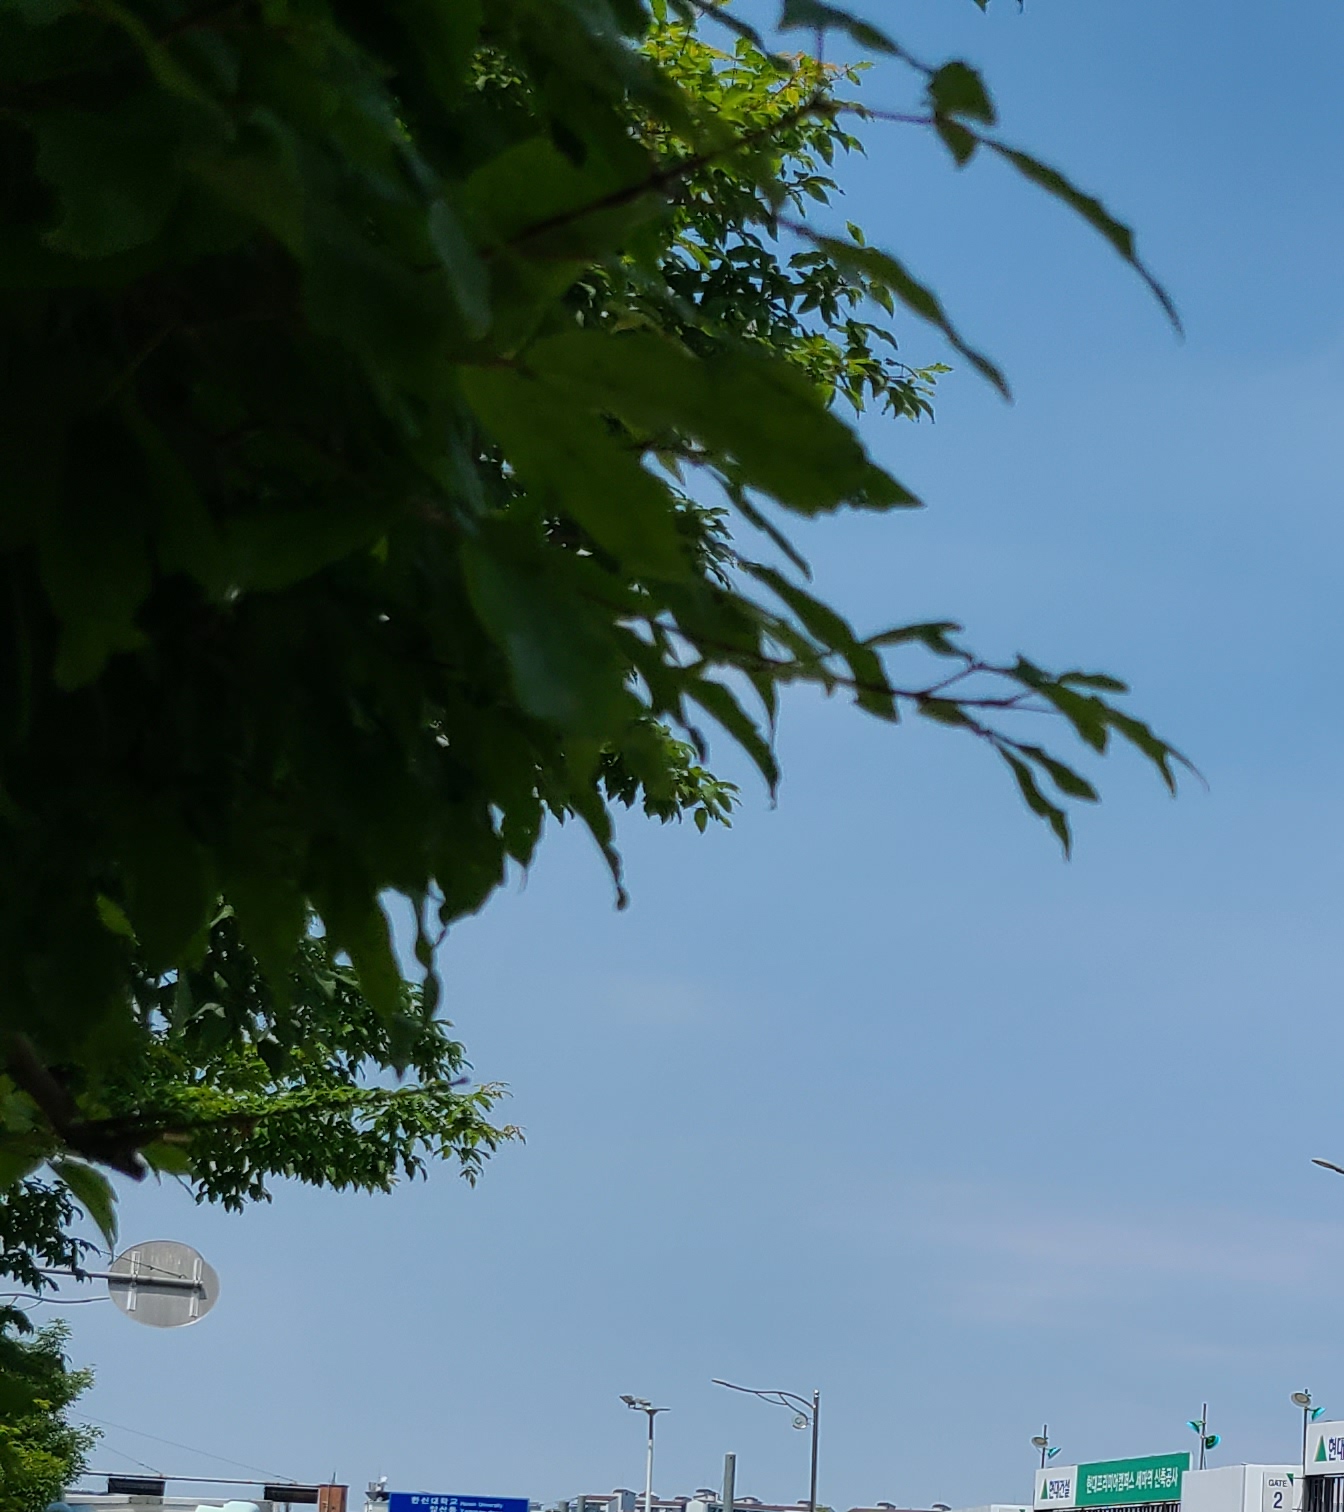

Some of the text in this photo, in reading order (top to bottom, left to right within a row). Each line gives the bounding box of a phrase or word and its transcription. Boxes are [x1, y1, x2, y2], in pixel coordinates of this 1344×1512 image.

[1048, 1478, 1071, 1499] 현대건설
[1086, 1472, 1135, 1495] 현대프리미어캠퍼스
[1268, 1479, 1288, 1488] GATE
[1273, 1492, 1283, 1509] 2
